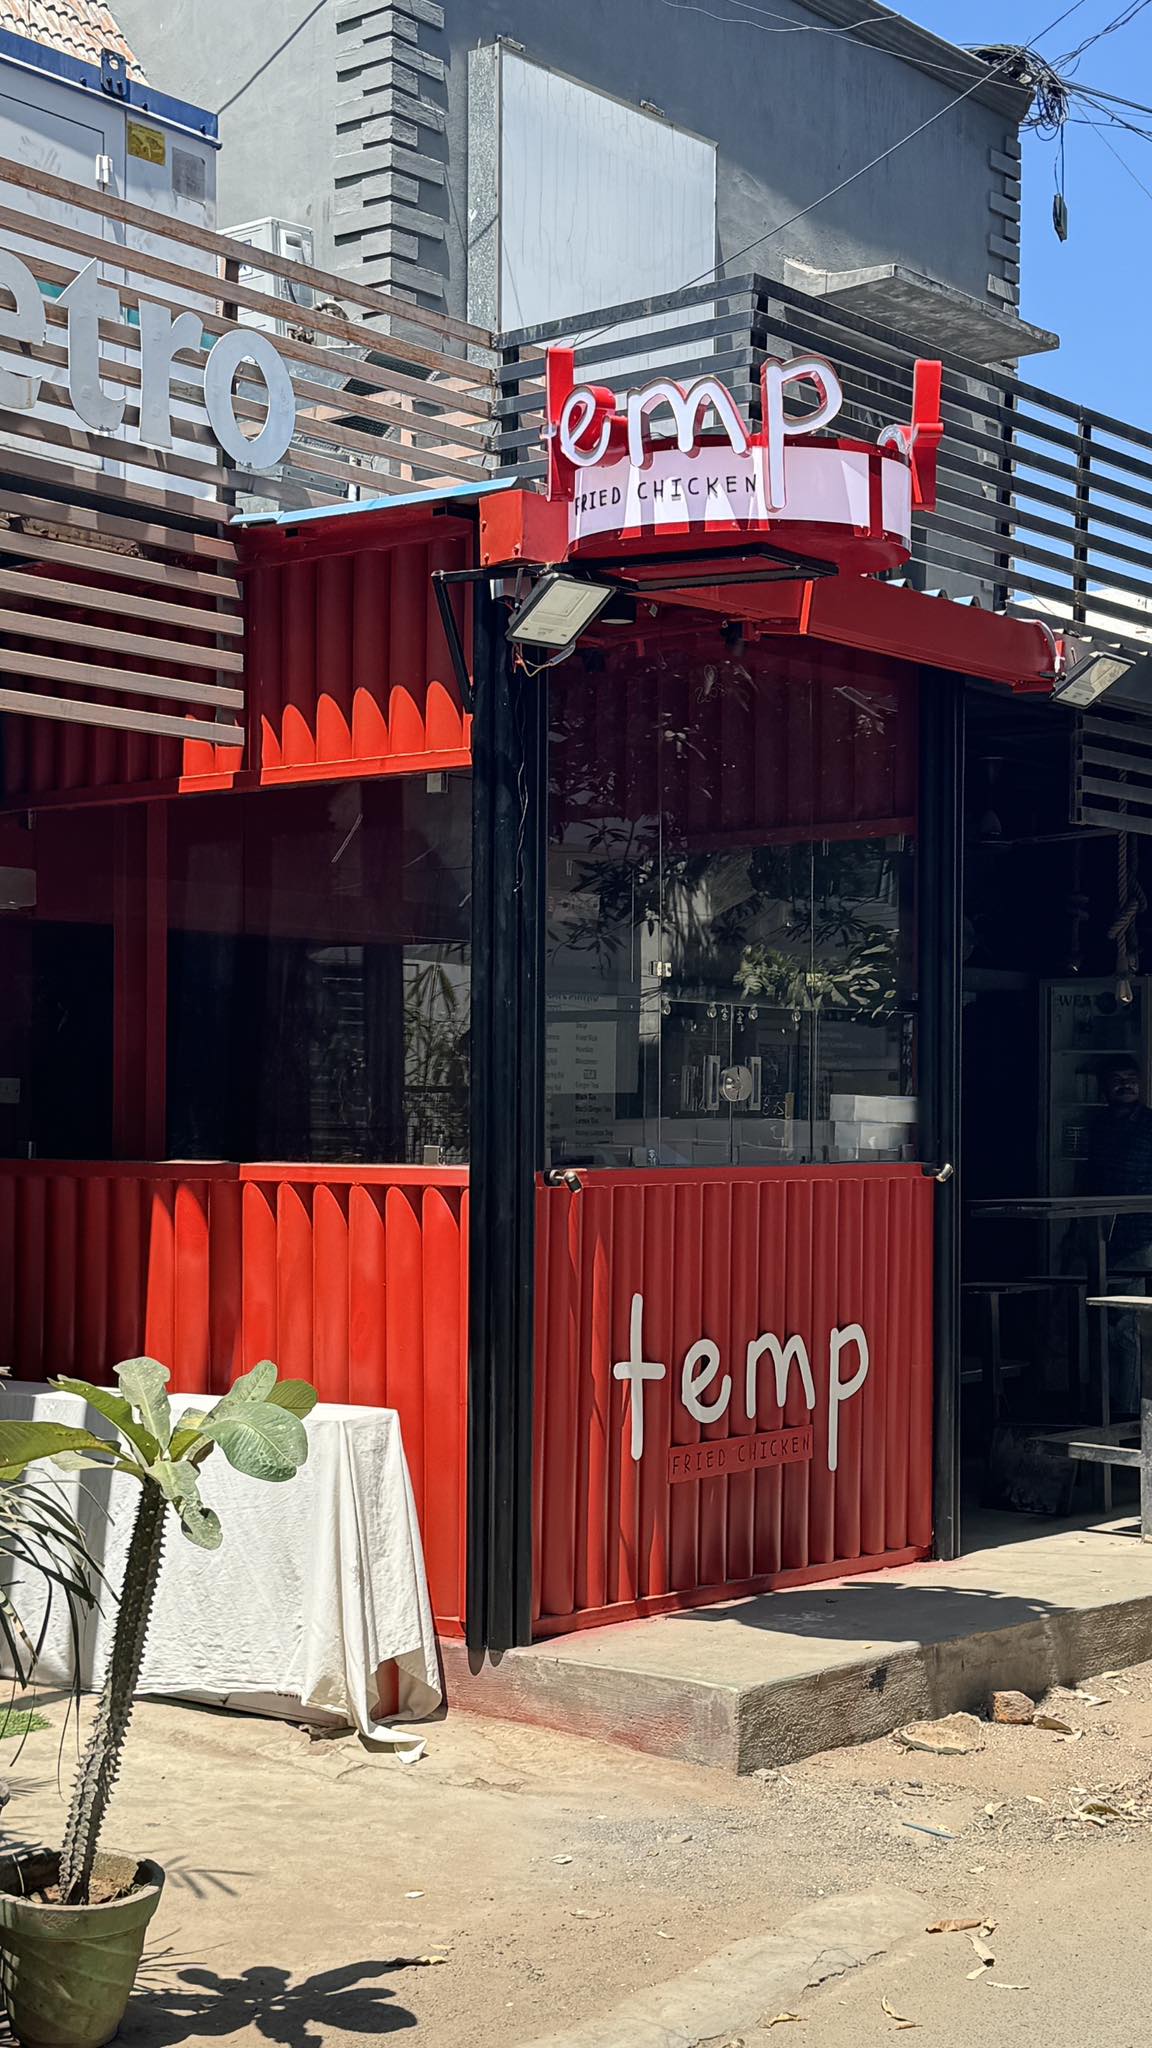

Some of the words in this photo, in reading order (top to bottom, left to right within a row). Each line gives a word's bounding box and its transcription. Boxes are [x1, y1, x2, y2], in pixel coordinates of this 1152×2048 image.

[574, 486, 622, 517] FRIED
[637, 474, 757, 500] CHICKEN
[613, 1293, 870, 1472] temp
[672, 1450, 726, 1475] FRIED
[737, 1432, 810, 1462] CHICKEN
